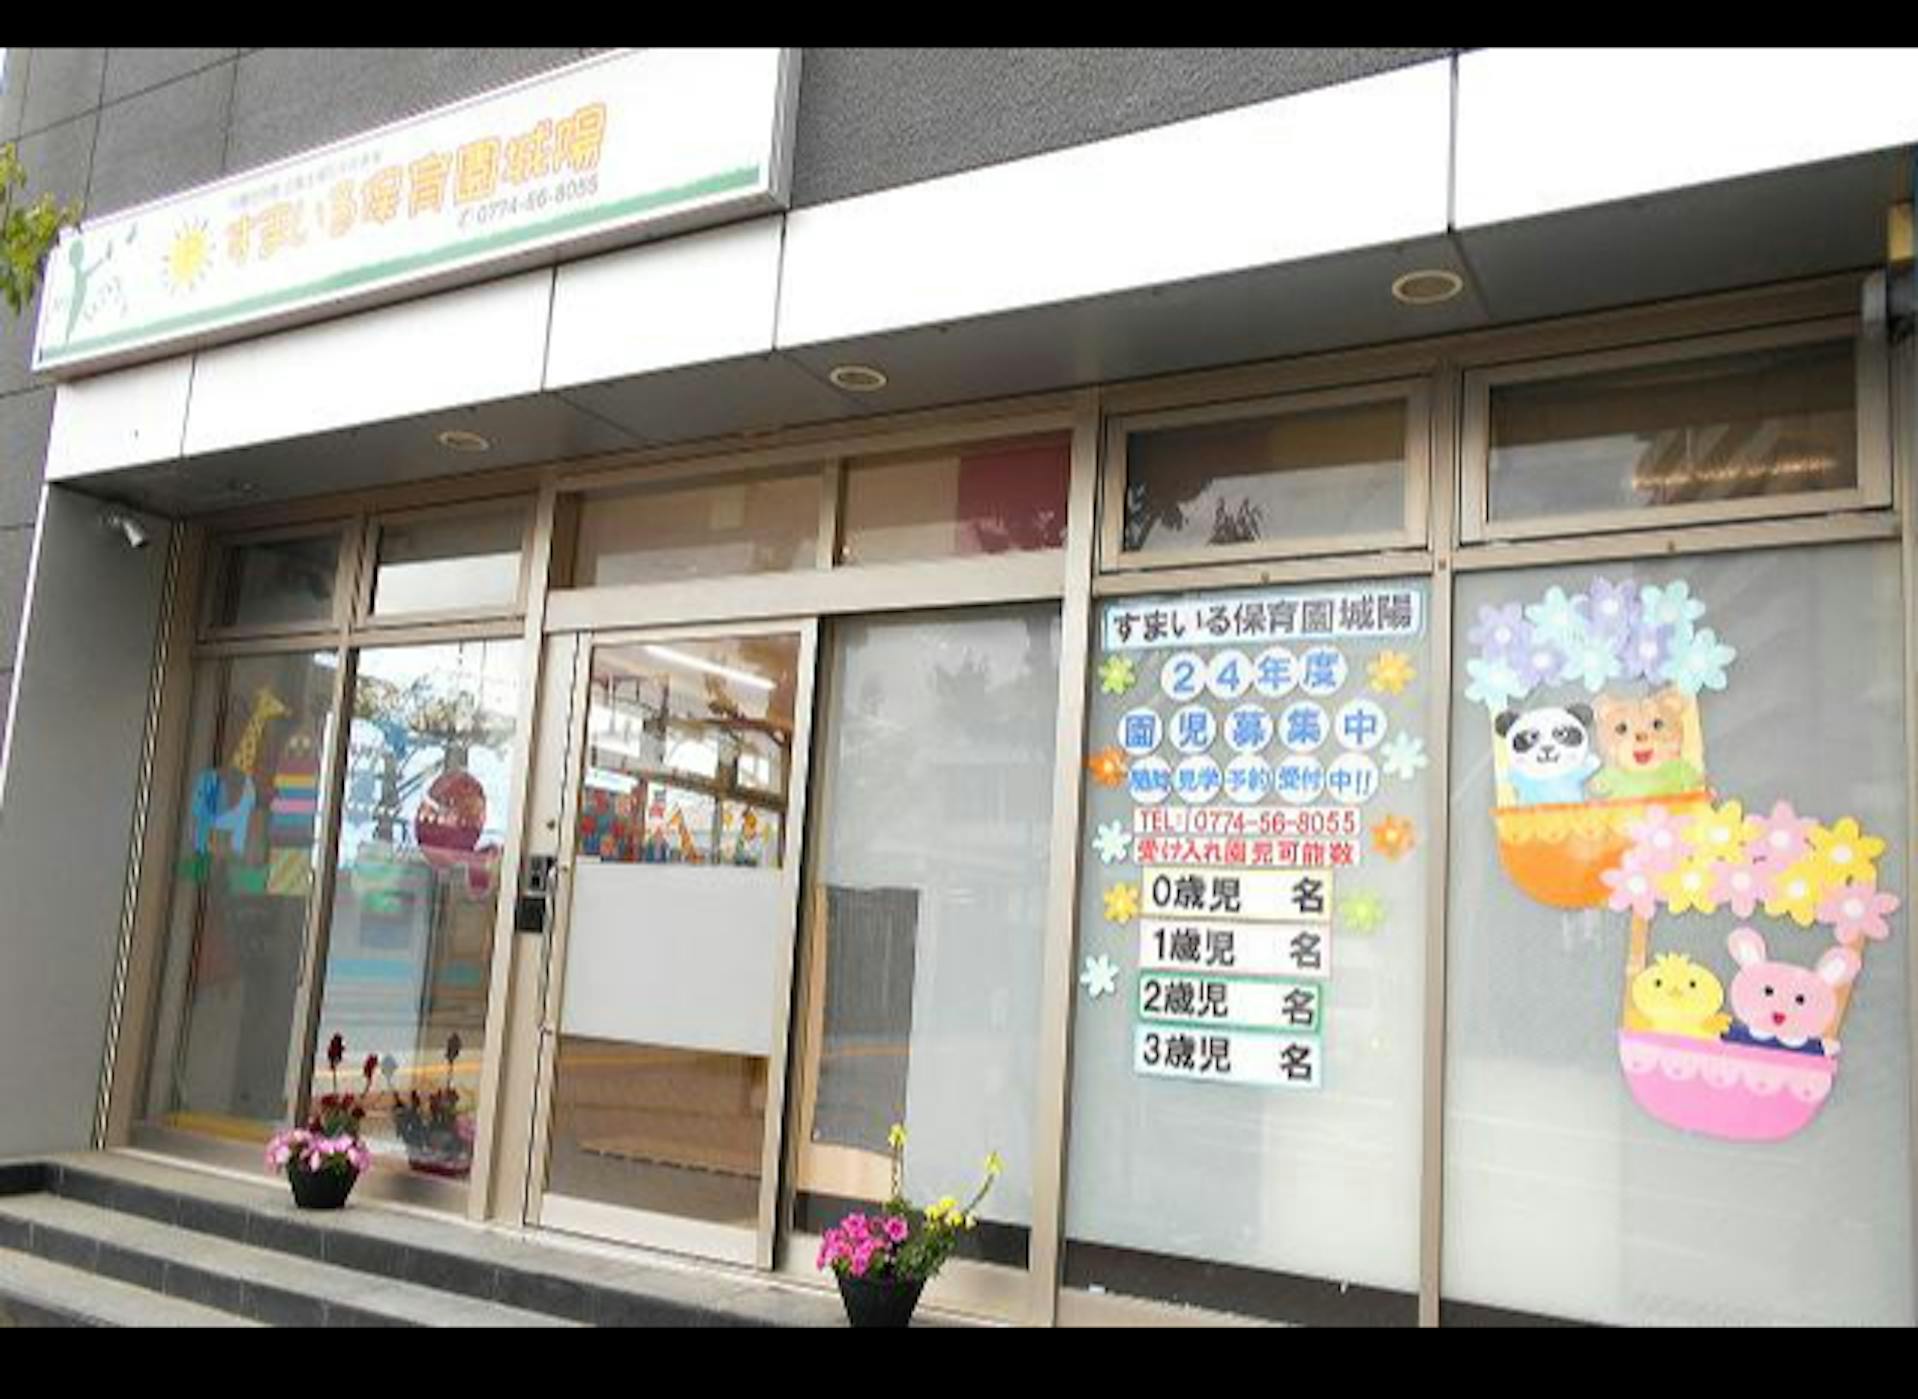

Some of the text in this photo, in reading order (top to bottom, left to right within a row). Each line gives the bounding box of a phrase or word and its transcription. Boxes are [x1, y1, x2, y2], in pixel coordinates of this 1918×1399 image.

[1113, 594, 1413, 642] すまいる保育園城陽
[1172, 650, 1340, 693] 24年度
[1125, 707, 1377, 748] 園児募集中
[1137, 839, 1354, 865] 受け入れ園児可能数
[1152, 873, 1324, 914] 0歳児 名
[1154, 928, 1322, 970] 1歳児 名
[1143, 980, 1315, 1026] 2歳児 名
[1143, 1033, 1312, 1081] 3歳児 名
